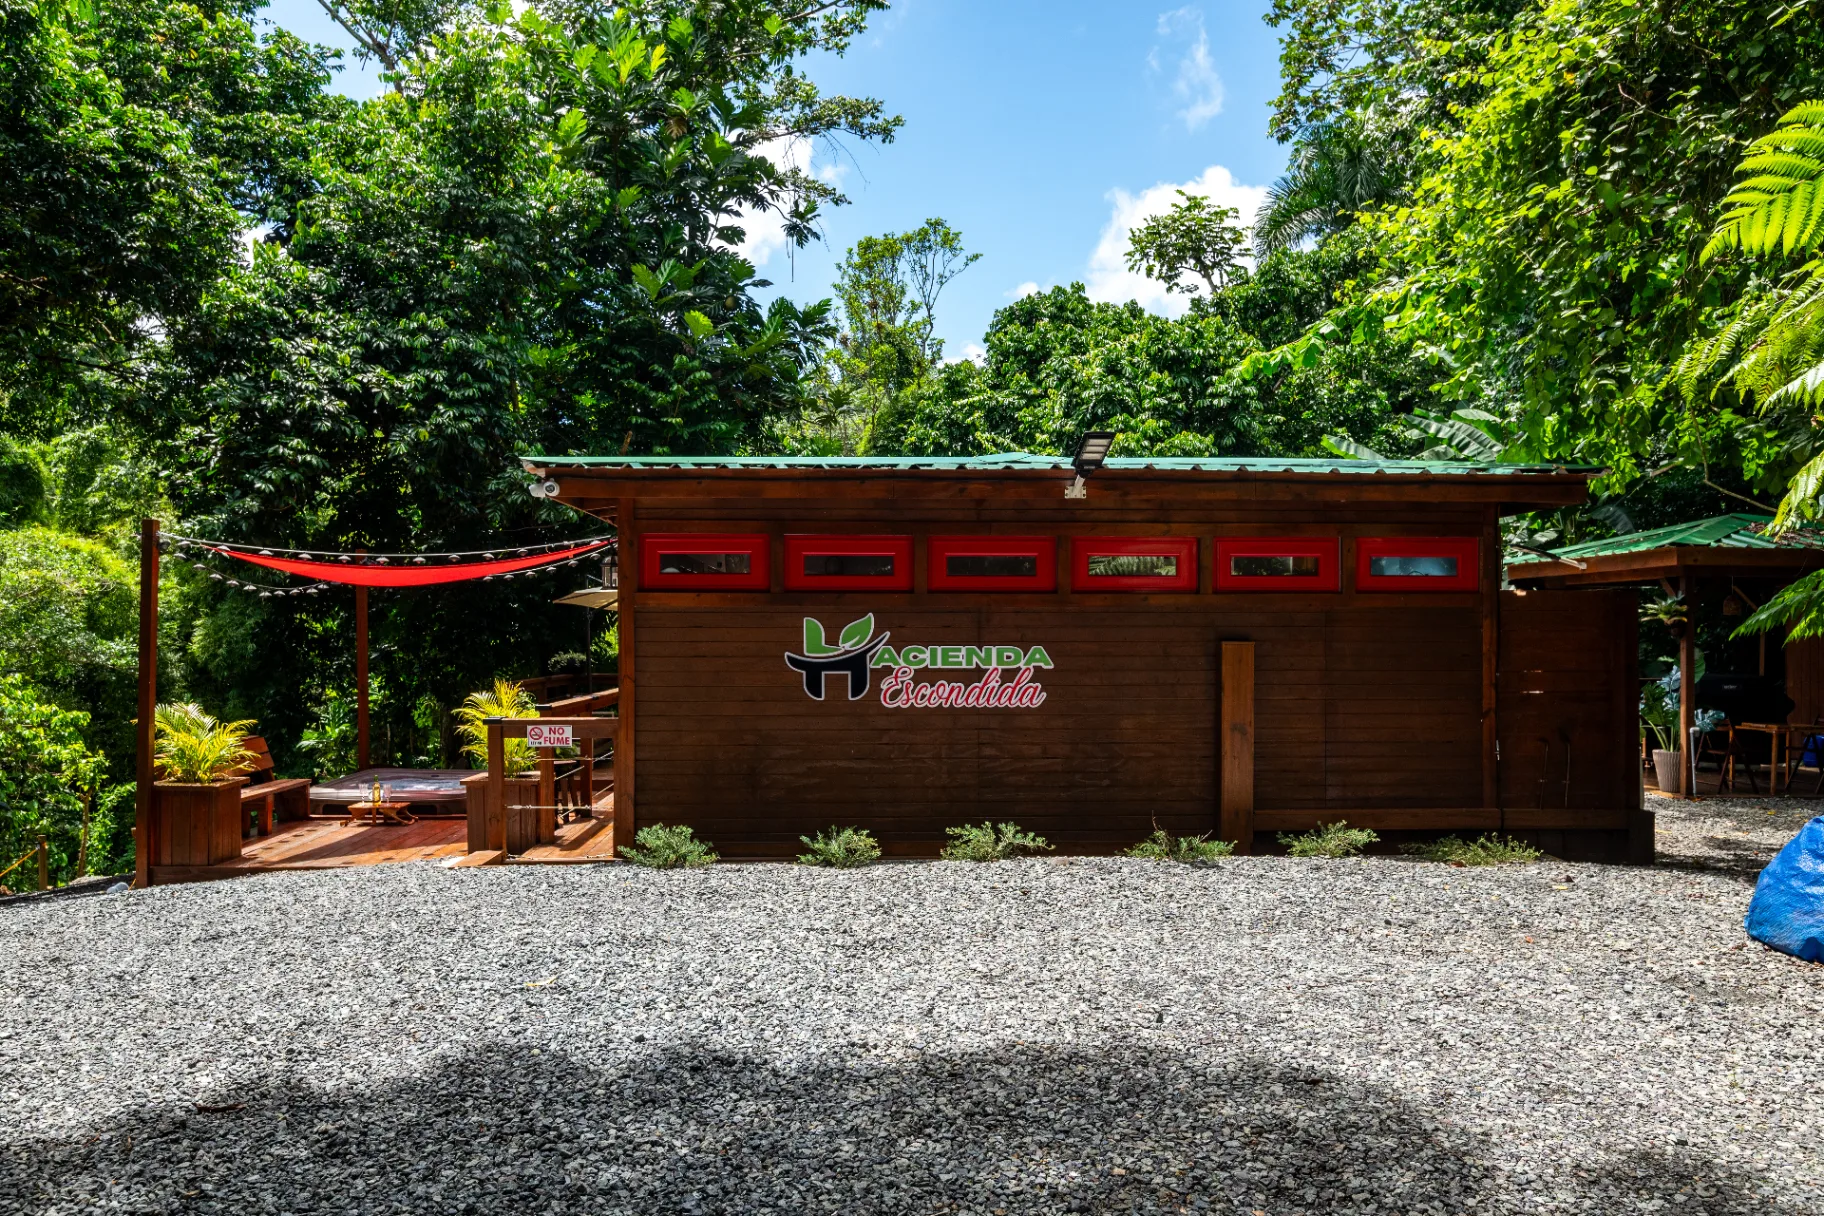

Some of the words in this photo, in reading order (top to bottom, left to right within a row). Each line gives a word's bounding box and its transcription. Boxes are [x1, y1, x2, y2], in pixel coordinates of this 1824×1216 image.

[881, 666, 1047, 707] Escondida
[549, 726, 565, 736] NO
[543, 736, 570, 745] FUME
